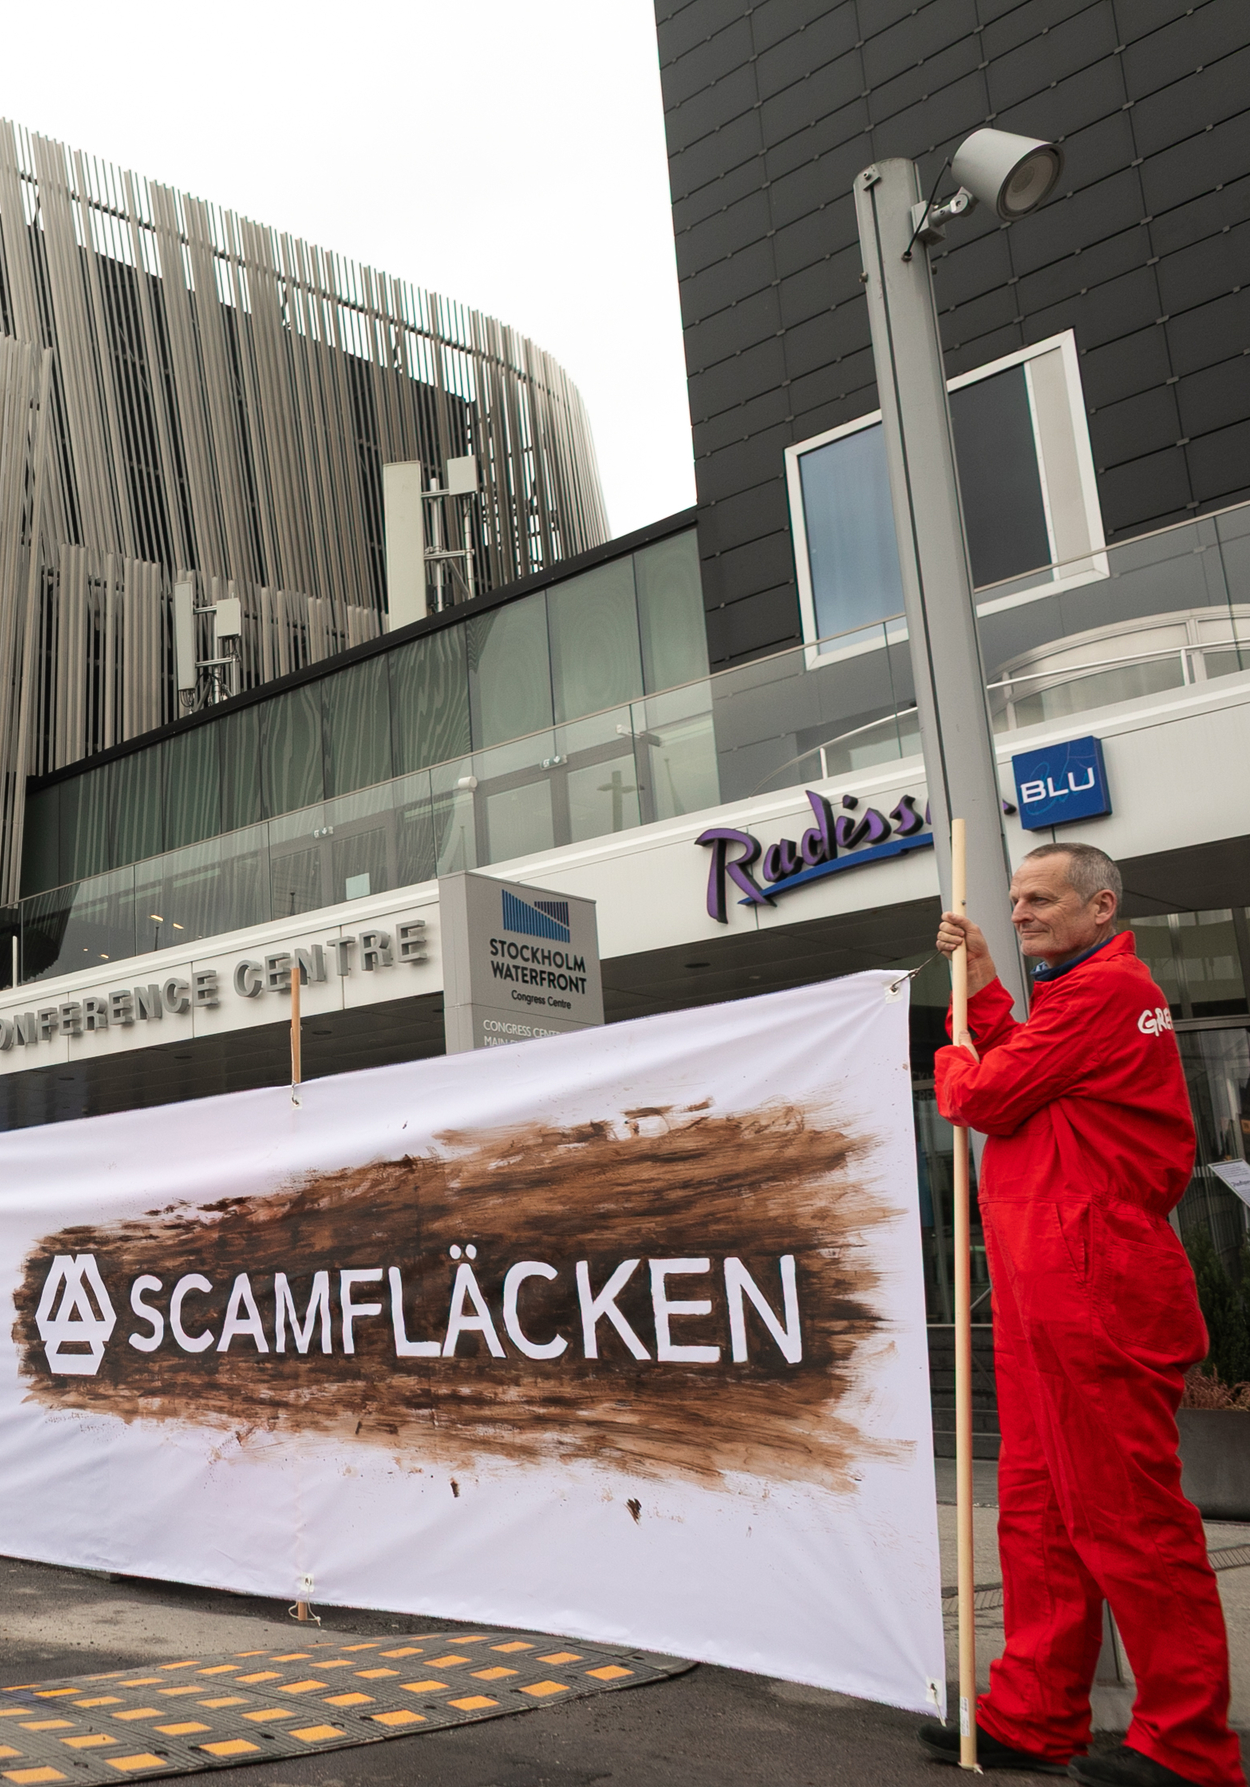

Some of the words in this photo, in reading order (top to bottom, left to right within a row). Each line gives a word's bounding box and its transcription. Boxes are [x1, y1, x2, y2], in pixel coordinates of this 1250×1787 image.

[694, 789, 1017, 924] Radiss
[1020, 767, 1095, 804] BLU
[233, 919, 428, 999] CENTRE
[489, 938, 587, 973] STOCKHOLM
[490, 960, 587, 994] WATERFRONT
[511, 990, 546, 1006] Congress
[547, 996, 572, 1010] Centre
[483, 1019, 532, 1037] CONGRESS
[127, 1243, 805, 1364] SCAMFLÄCKEN
